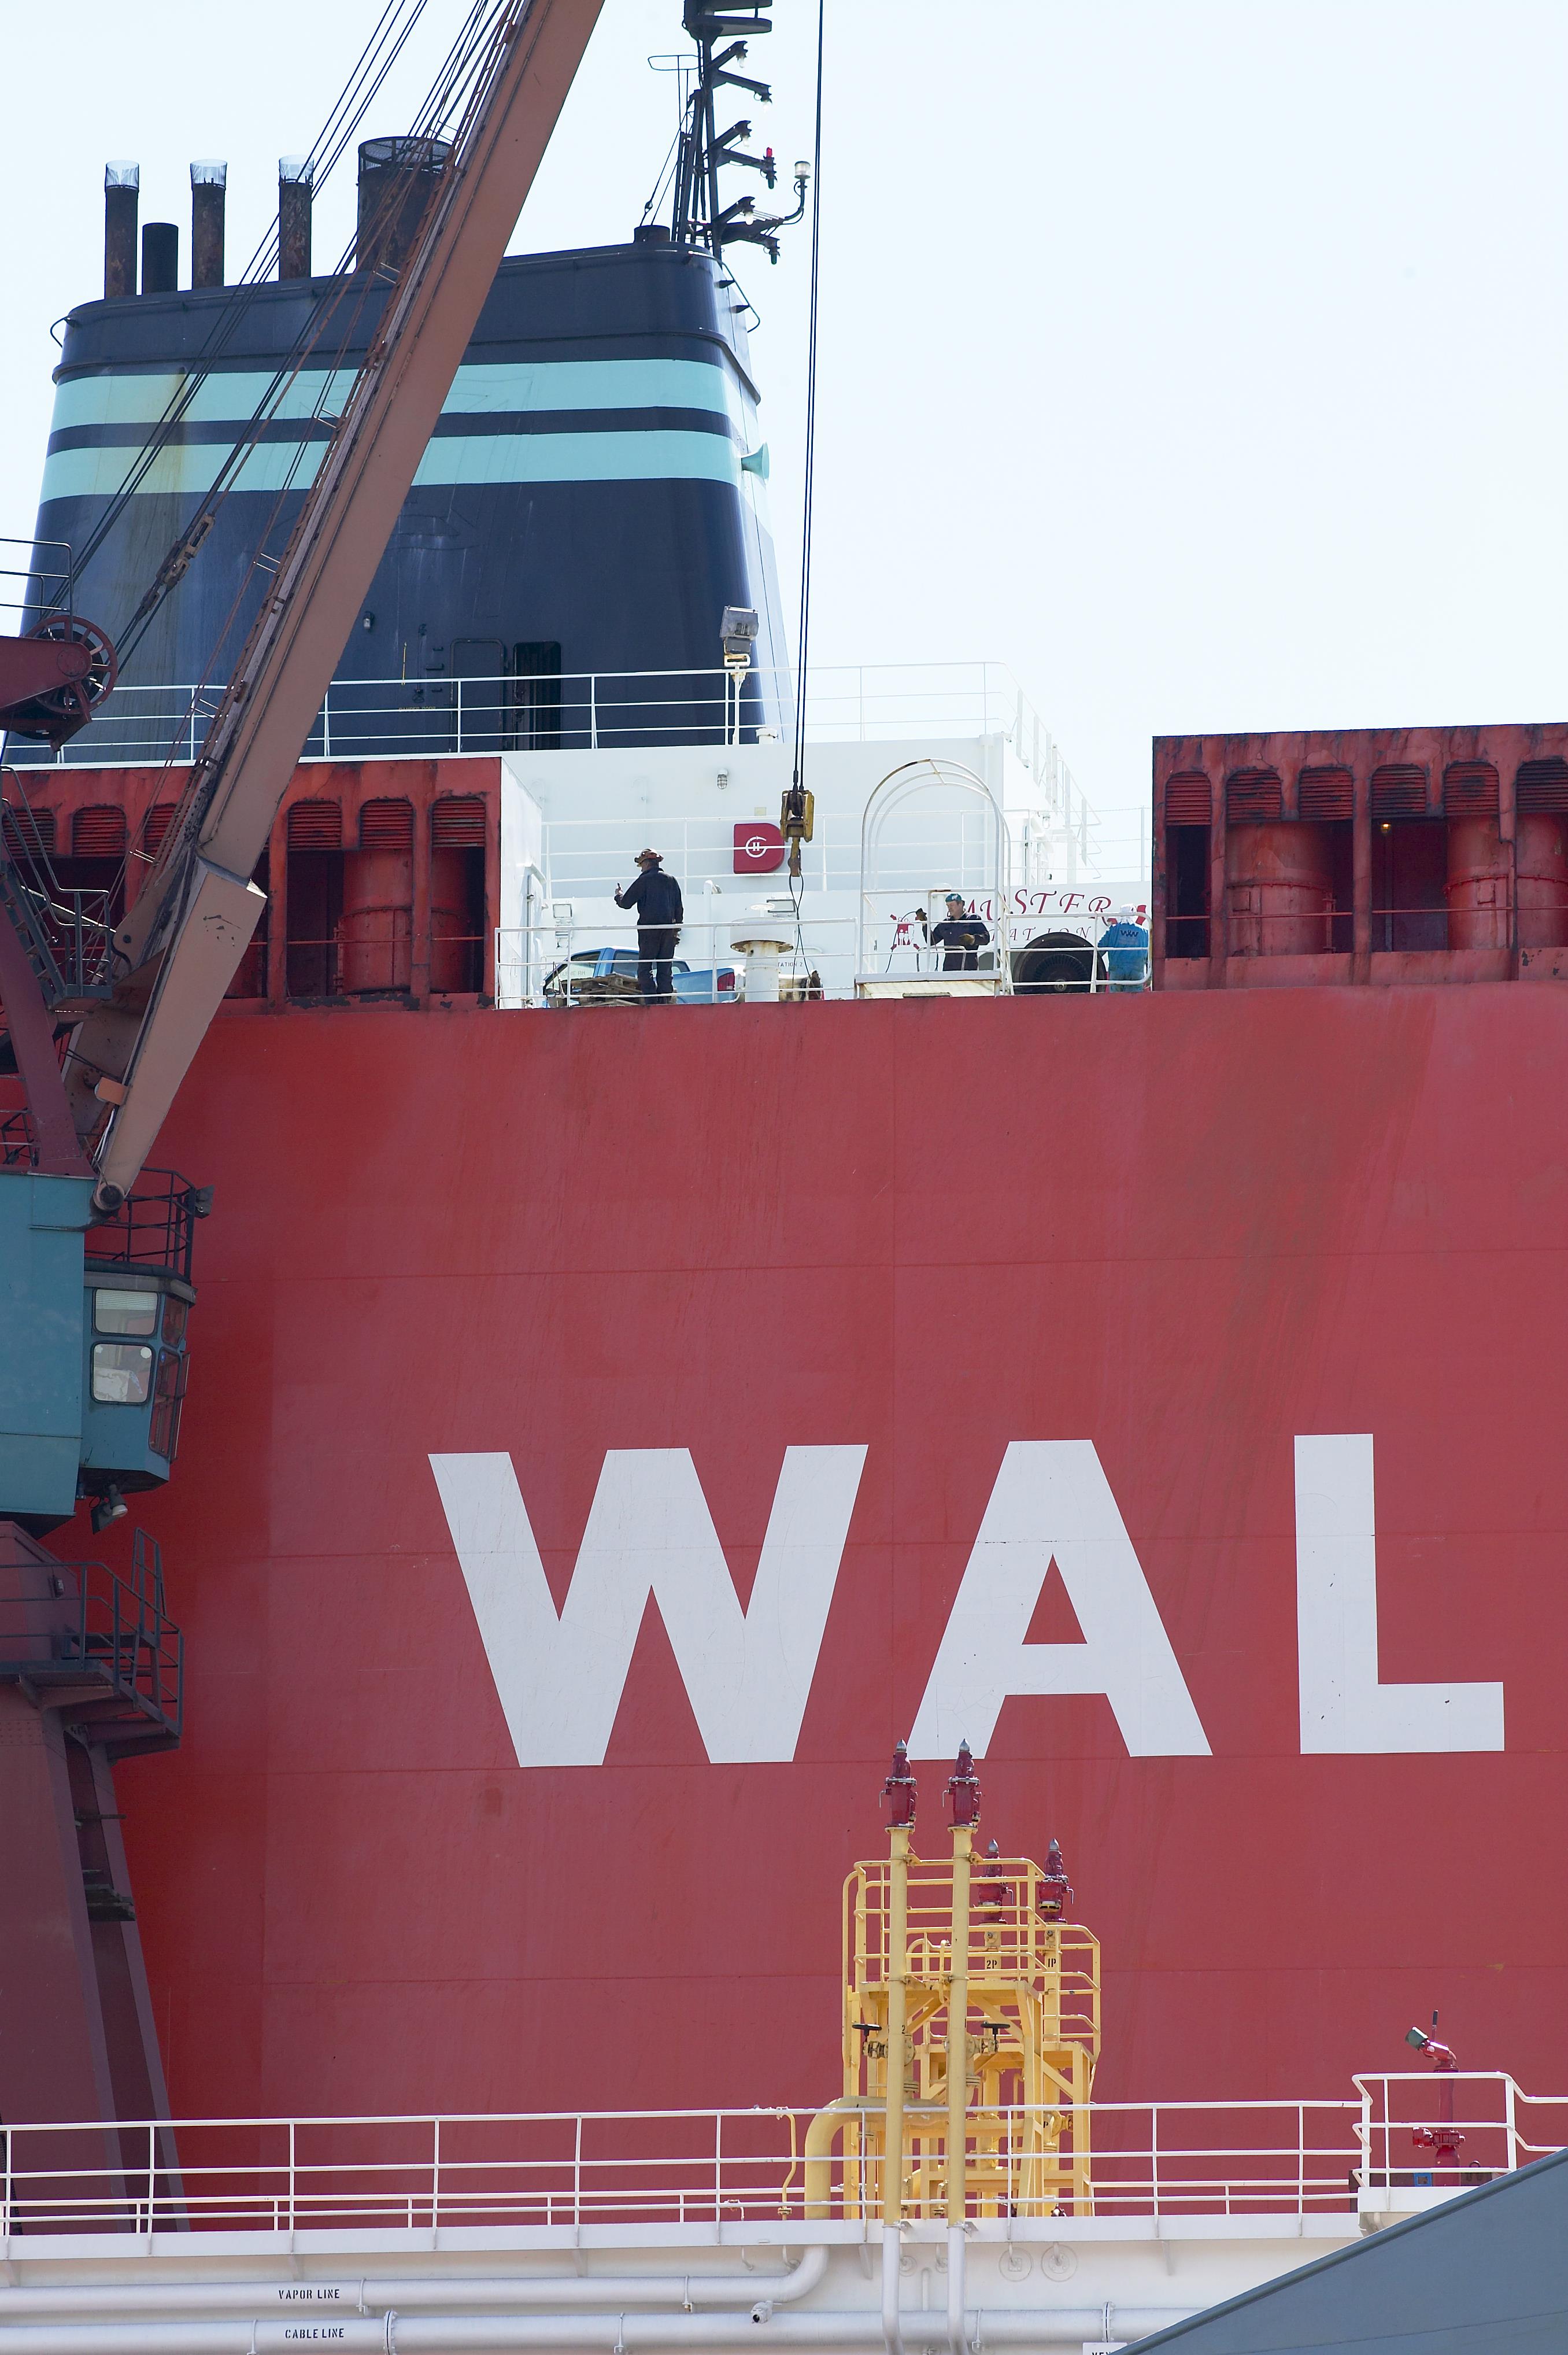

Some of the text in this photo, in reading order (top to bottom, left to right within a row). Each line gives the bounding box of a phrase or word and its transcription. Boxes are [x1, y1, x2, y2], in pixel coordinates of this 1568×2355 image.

[986, 1959, 997, 1969] 2P
[278, 2289, 340, 2299] VAPOR LINE
[285, 2328, 345, 2339] CABLE LINE
